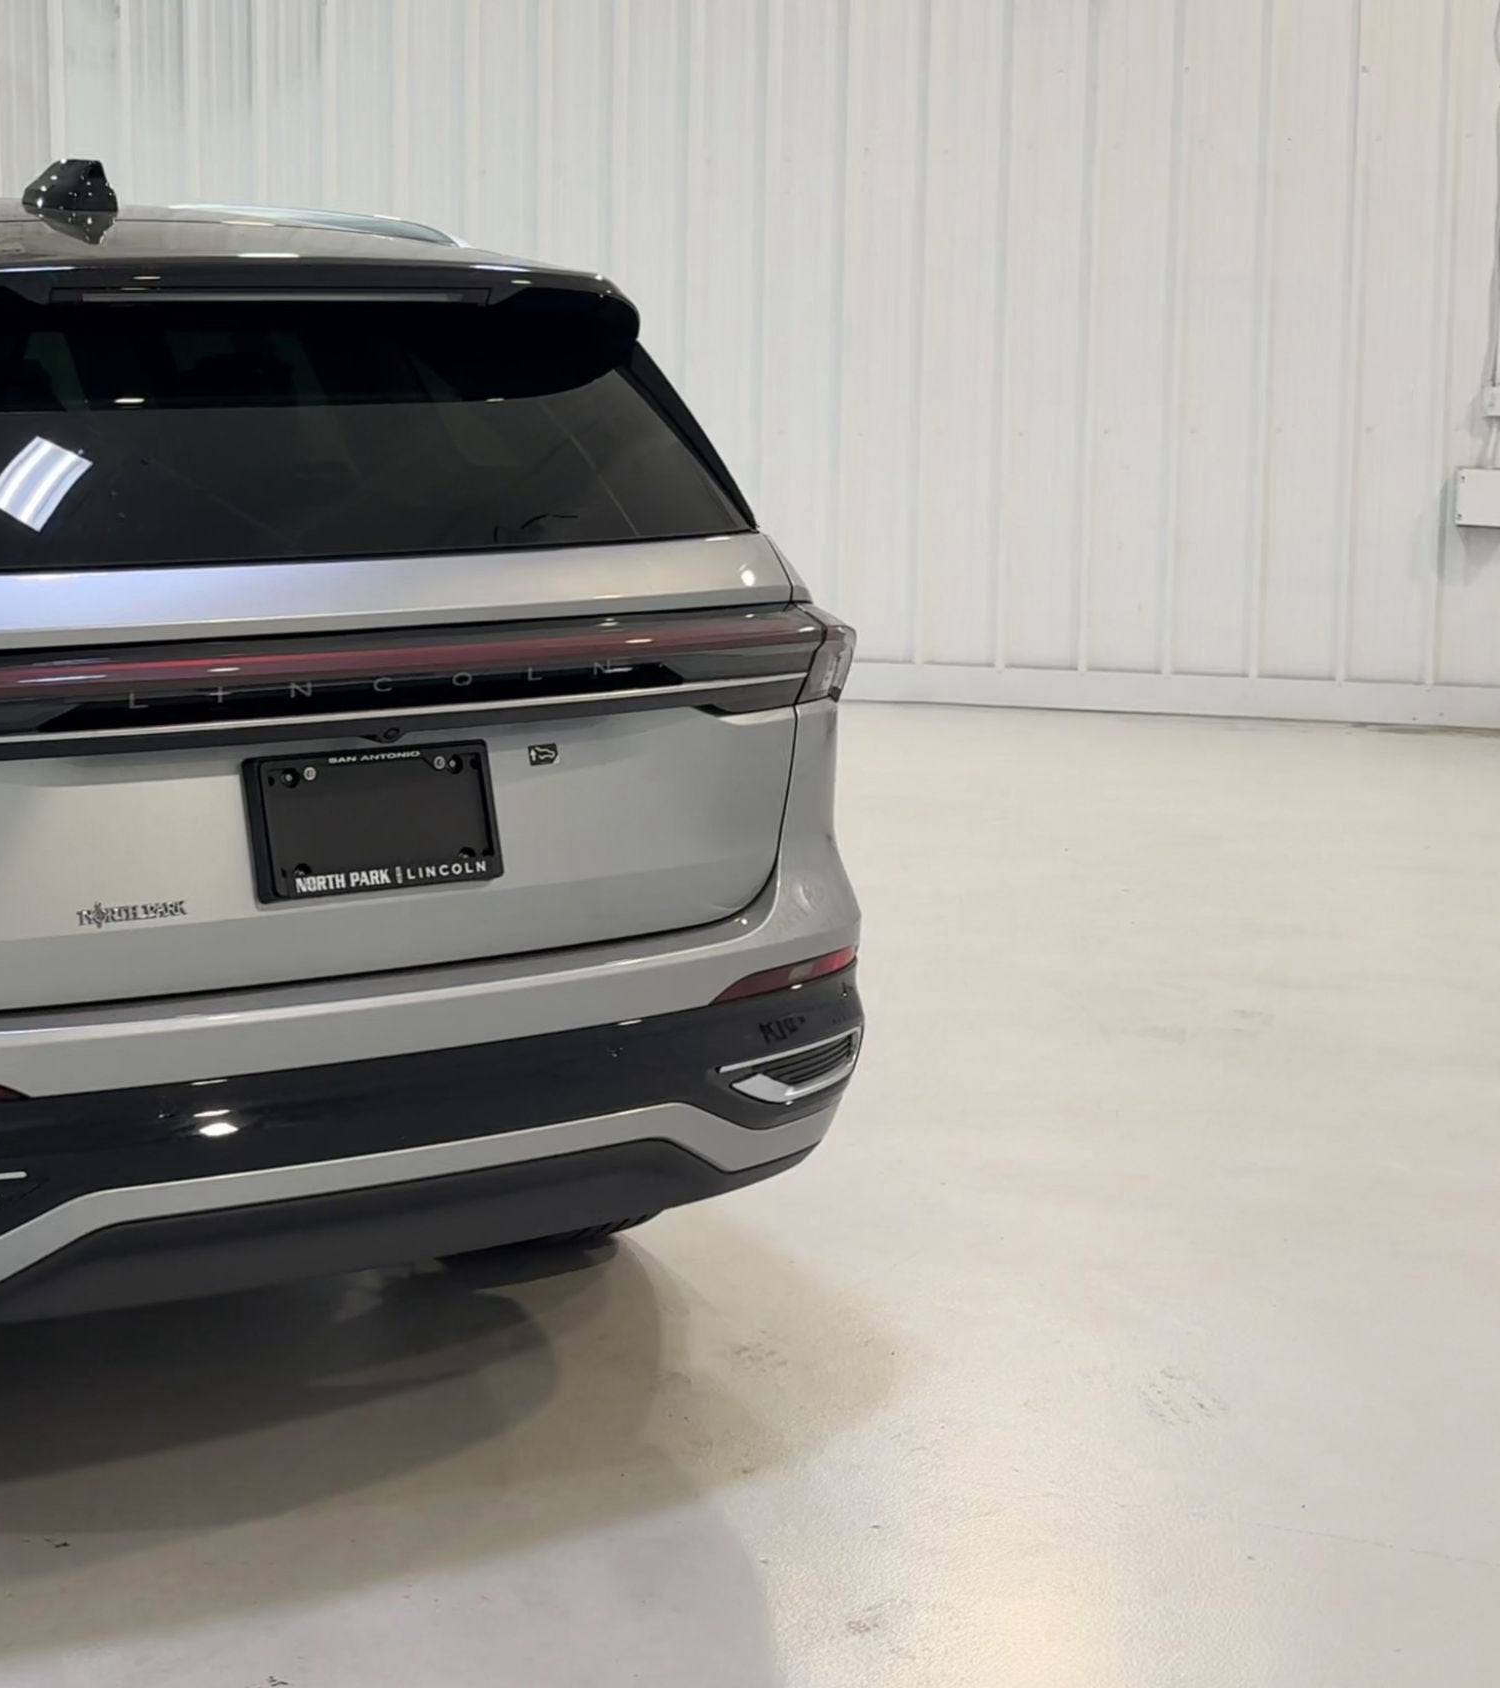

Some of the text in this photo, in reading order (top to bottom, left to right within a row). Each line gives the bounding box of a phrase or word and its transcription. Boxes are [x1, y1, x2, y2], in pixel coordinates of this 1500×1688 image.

[128, 660, 611, 709] LINCOLN
[328, 750, 421, 764] SAN ANTONIO
[295, 861, 487, 893] NORTH PARK LINCOLN
